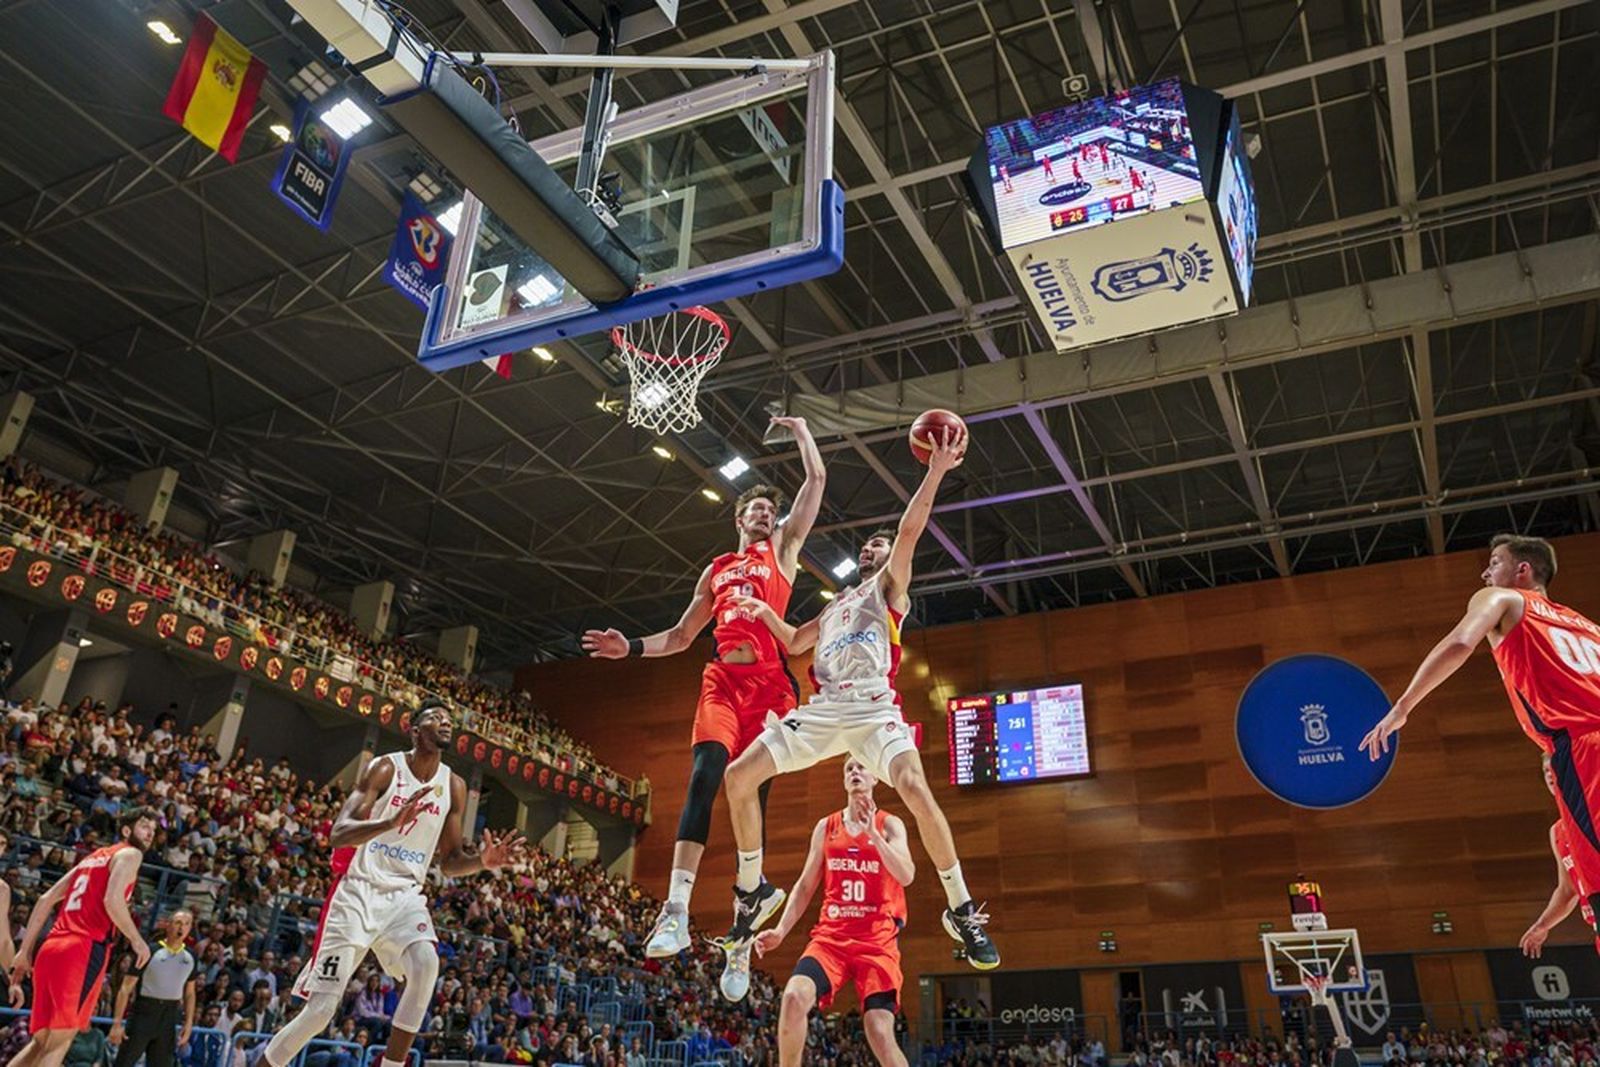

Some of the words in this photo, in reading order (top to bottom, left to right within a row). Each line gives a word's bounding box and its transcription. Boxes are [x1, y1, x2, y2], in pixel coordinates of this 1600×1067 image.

[294, 161, 325, 197] FIBA
[1115, 198, 1128, 211] 27
[1026, 261, 1077, 332] HUELVA
[1055, 258, 1090, 314] Ayuntamiento
[1082, 314, 1096, 326] de
[822, 631, 877, 657] endesa
[1298, 752, 1345, 766] HUELVA
[369, 840, 426, 864] endesa
[827, 858, 880, 874] NEDERLAND
[64, 874, 89, 912] 2
[841, 879, 866, 903] 30
[322, 956, 340, 977] fi
[1542, 973, 1560, 993] fi
[1000, 1003, 1075, 1024] endesa
[1524, 1005, 1593, 1019] finetwrk
